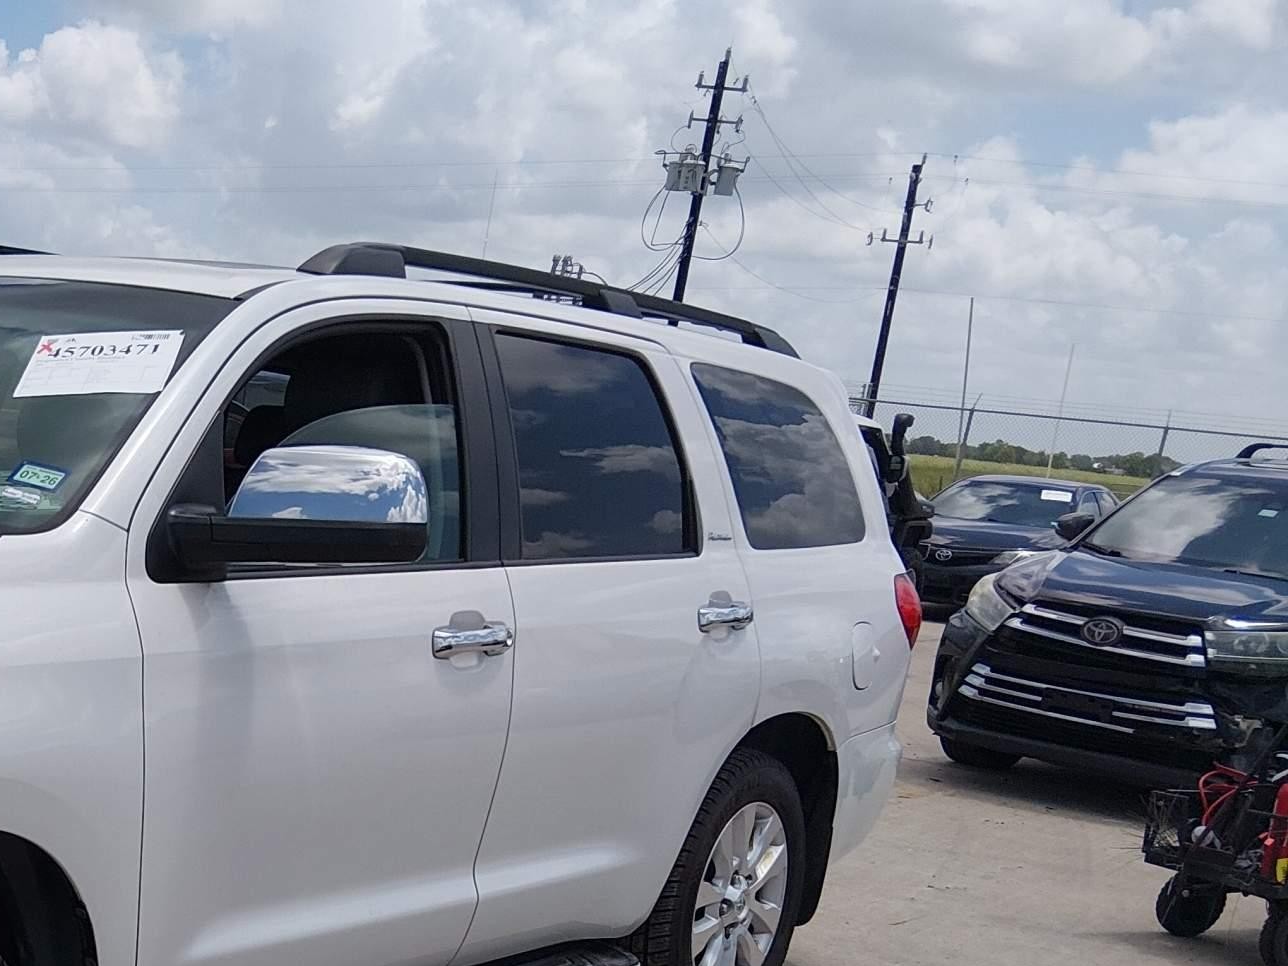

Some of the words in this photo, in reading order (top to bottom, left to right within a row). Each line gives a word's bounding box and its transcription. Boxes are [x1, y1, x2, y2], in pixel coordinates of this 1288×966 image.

[47, 343, 160, 358] 45703471
[19, 470, 37, 480] 07
[40, 475, 59, 486] 26
